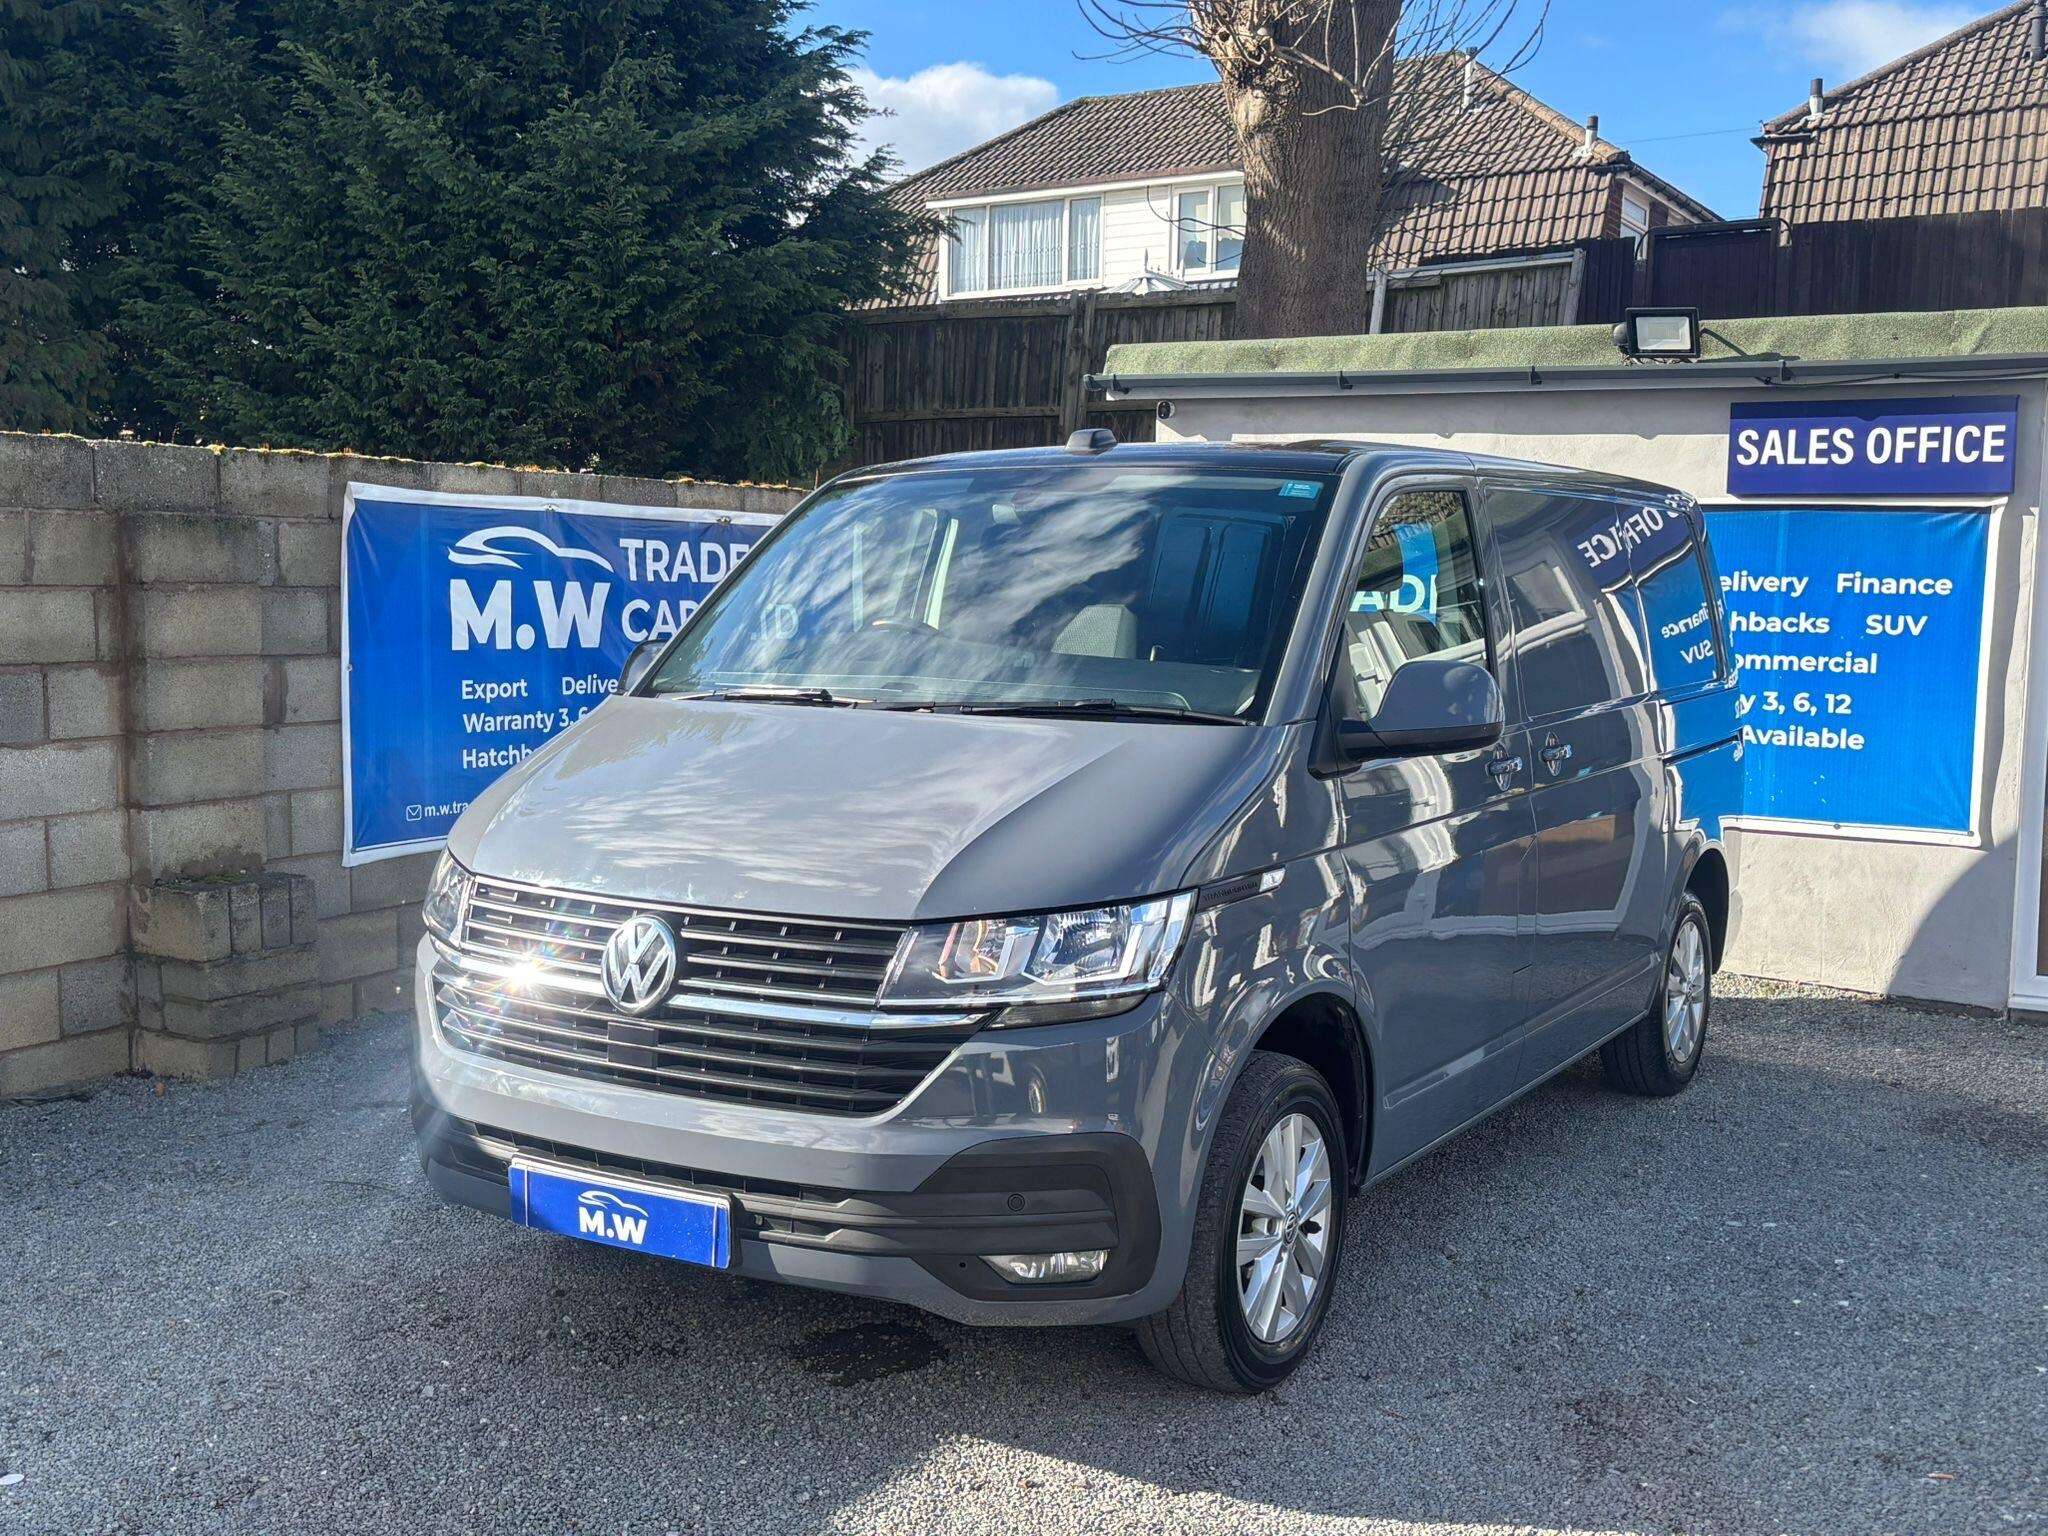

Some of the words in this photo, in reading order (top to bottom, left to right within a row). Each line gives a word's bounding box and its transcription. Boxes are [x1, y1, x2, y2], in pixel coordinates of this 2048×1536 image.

[1735, 428, 1855, 466] SALES
[1866, 424, 2007, 464] OFFICE
[1836, 571, 1954, 596] Finance
[449, 578, 612, 652] M.W
[1865, 614, 1928, 637] SUV
[461, 678, 528, 702] Export
[561, 673, 619, 695] Delive
[1763, 691, 1786, 715] 3,
[1793, 692, 1818, 716] 6,
[1824, 693, 1852, 714] 12
[462, 709, 555, 733] Warranty
[1742, 724, 1866, 751] Available
[578, 1206, 648, 1245] M.W
